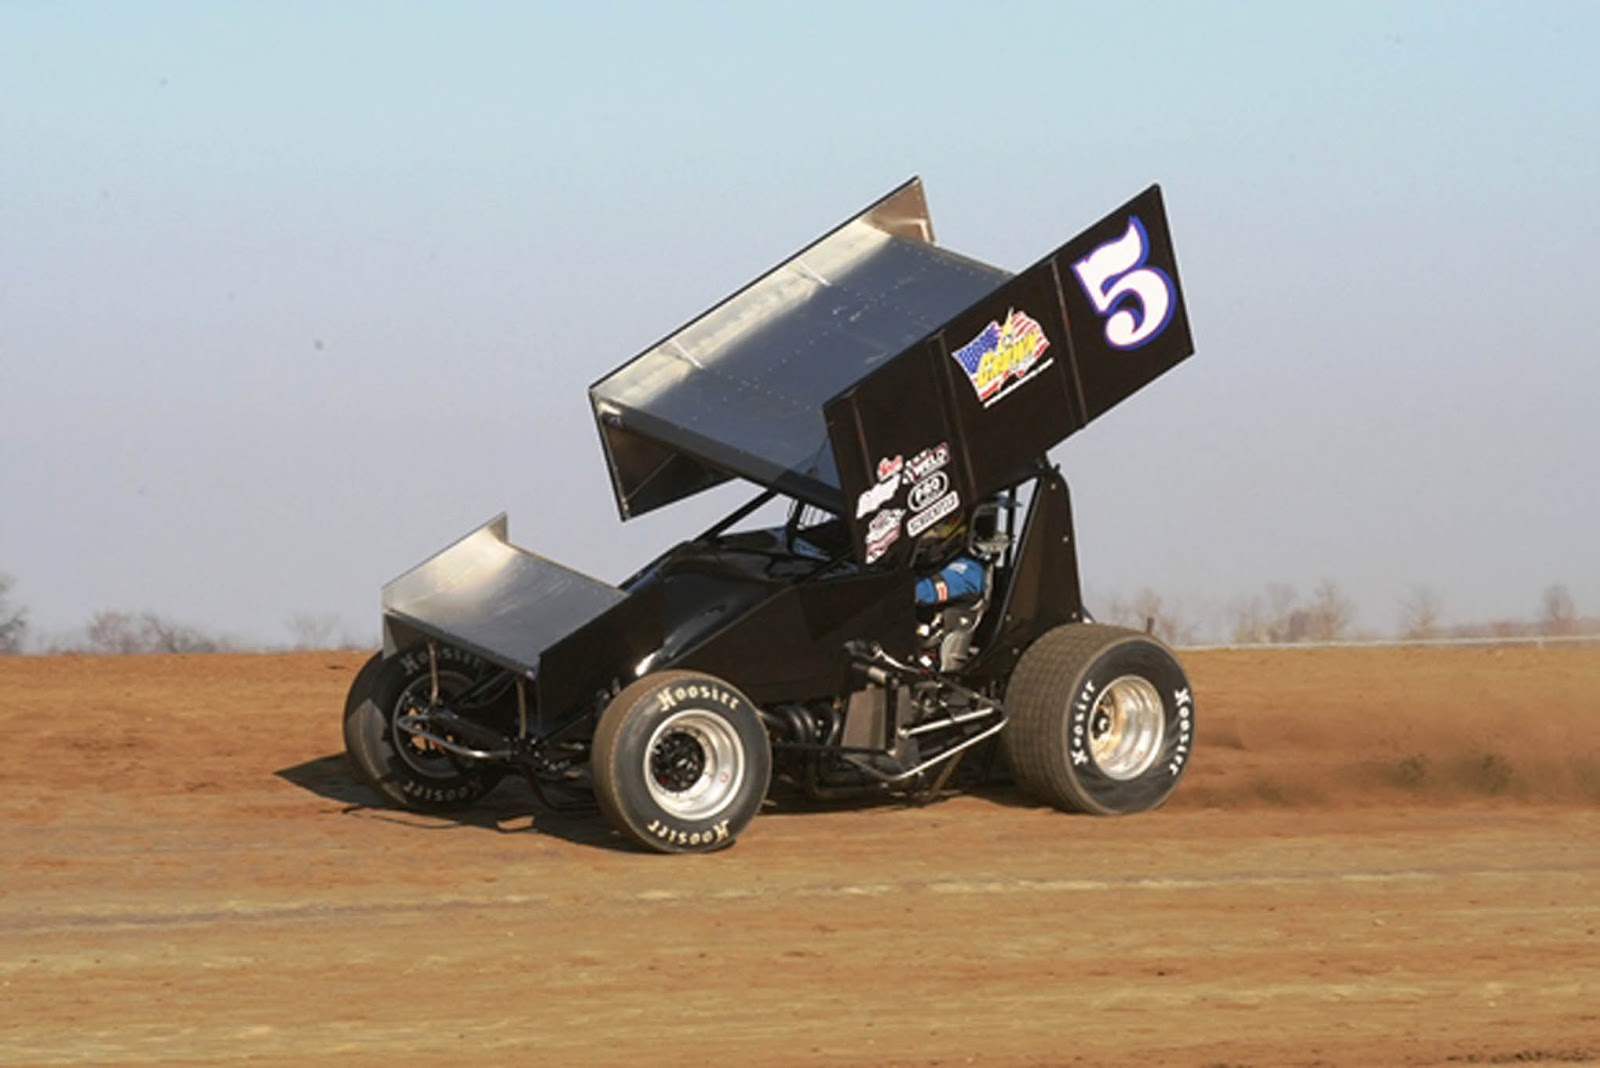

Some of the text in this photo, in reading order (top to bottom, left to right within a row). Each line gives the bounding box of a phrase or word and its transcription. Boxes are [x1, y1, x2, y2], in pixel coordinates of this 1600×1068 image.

[1070, 215, 1178, 350] 5
[656, 684, 741, 712] Hoosier
[1070, 680, 1096, 766] Hoosier
[1169, 687, 1192, 776] Hoosier
[646, 818, 732, 846] Hoosier
